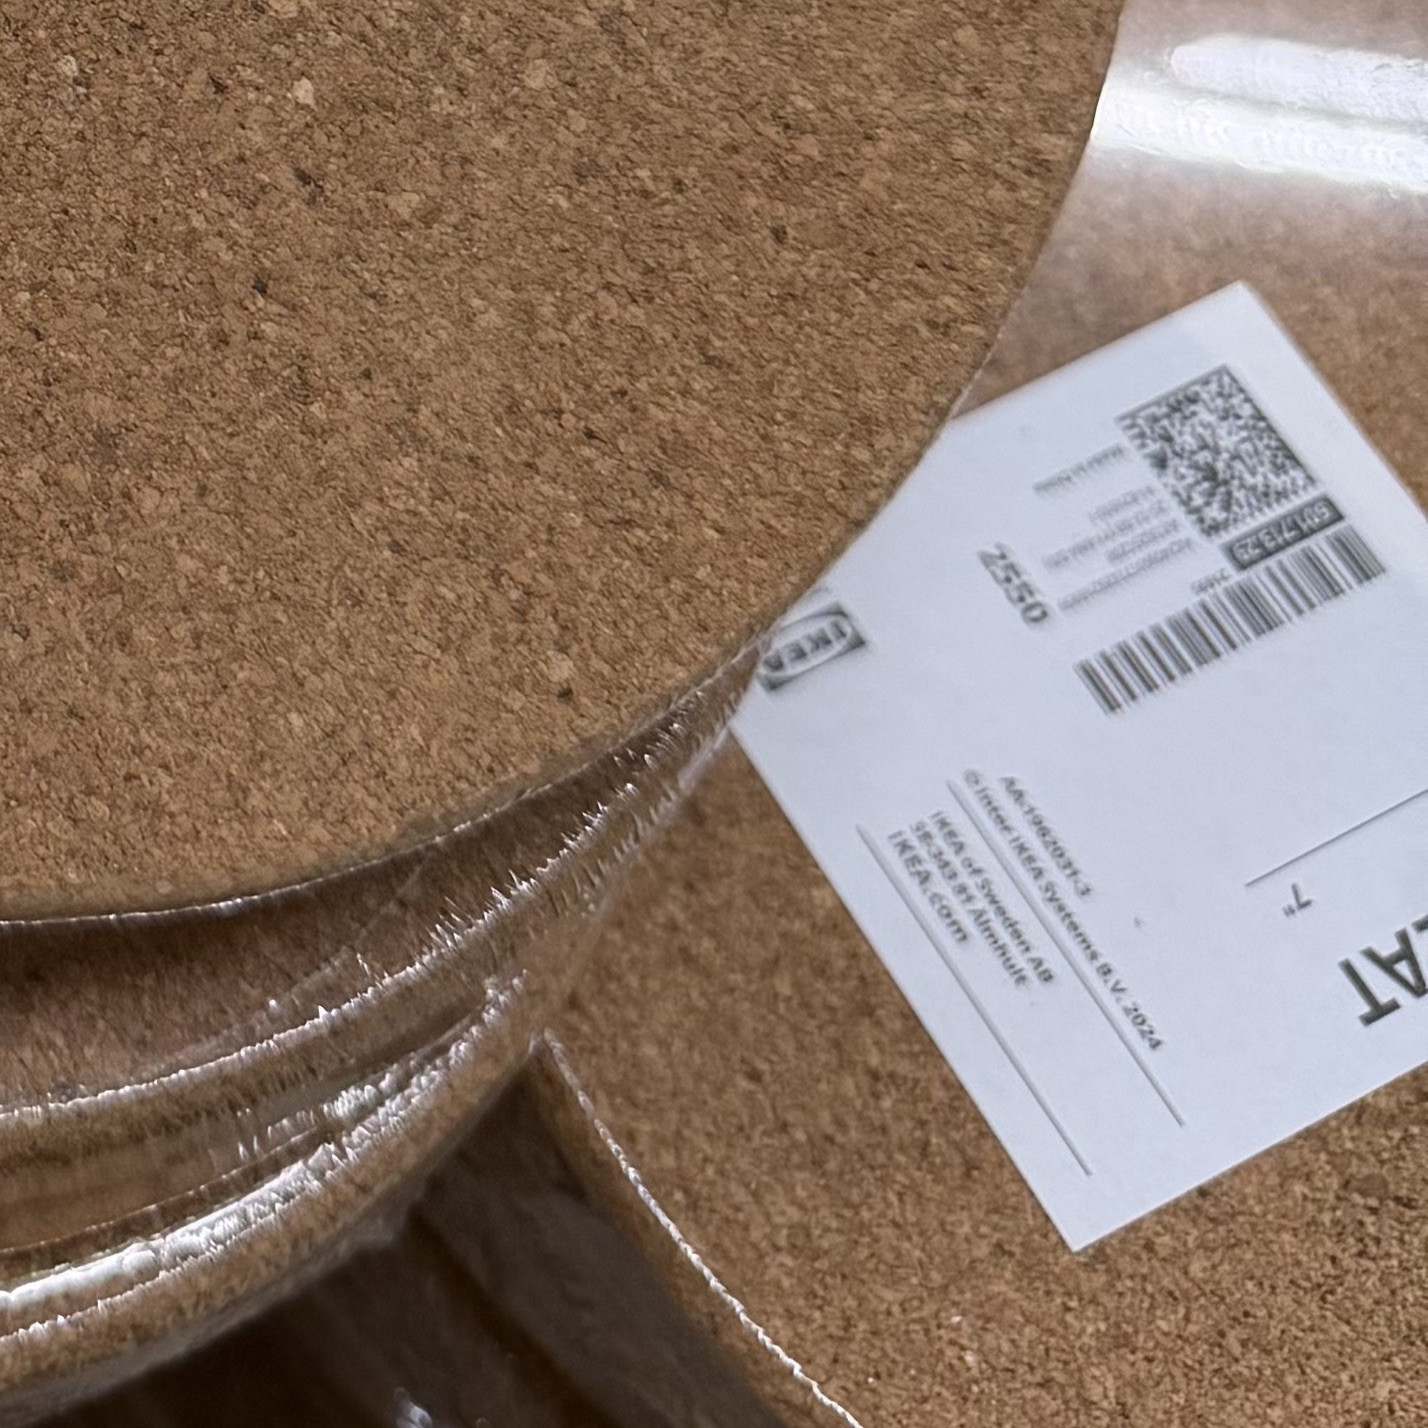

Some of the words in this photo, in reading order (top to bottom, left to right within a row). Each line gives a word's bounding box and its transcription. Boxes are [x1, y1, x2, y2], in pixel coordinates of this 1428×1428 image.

[887, 829, 969, 946] IKEA.com
[929, 810, 966, 856] IKEA
[960, 856, 984, 880] of
[975, 876, 1032, 957] Sweden
[977, 788, 1013, 836] Inter
[1011, 834, 1046, 880] IKEA
[1040, 879, 1099, 964] Systems
[1122, 1000, 1165, 1051] 2024
